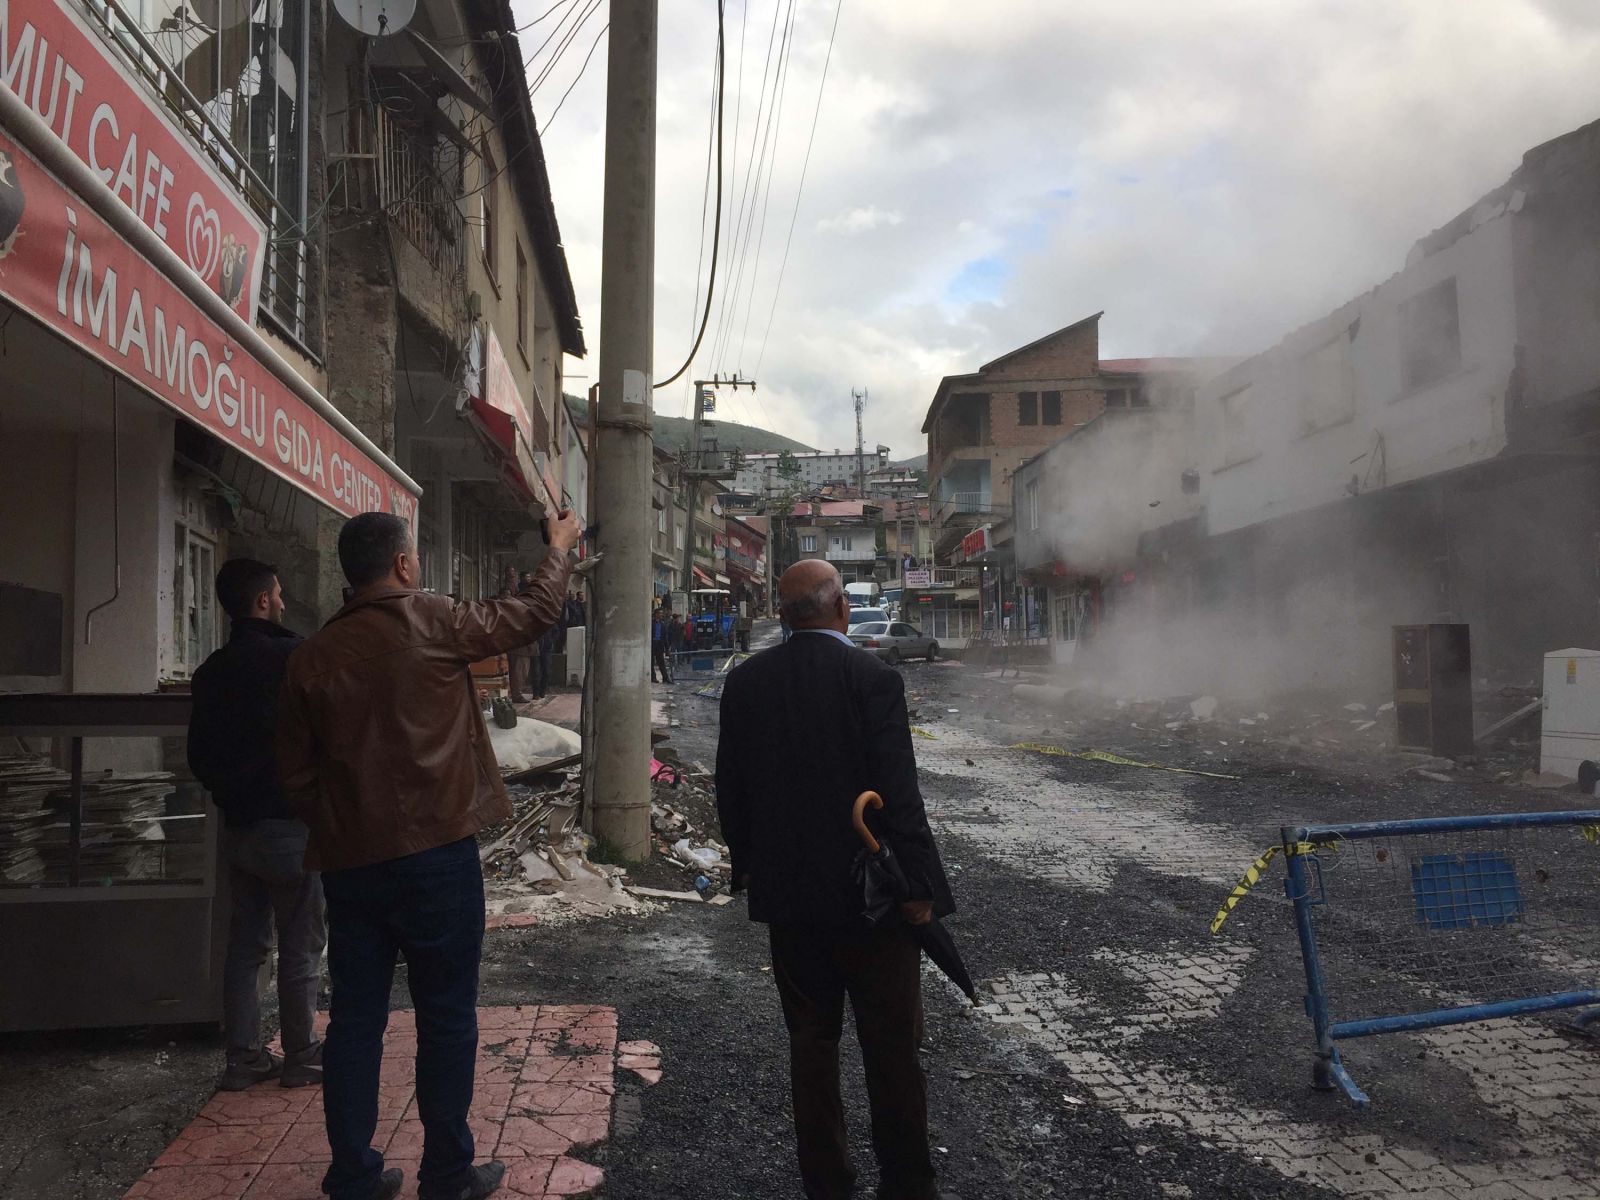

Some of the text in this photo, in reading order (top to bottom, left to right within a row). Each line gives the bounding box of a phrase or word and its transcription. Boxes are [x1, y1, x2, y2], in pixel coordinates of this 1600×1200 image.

[88, 102, 175, 241] CAFE
[56, 206, 382, 513] İMAMOĞLU GIDA CENTER
